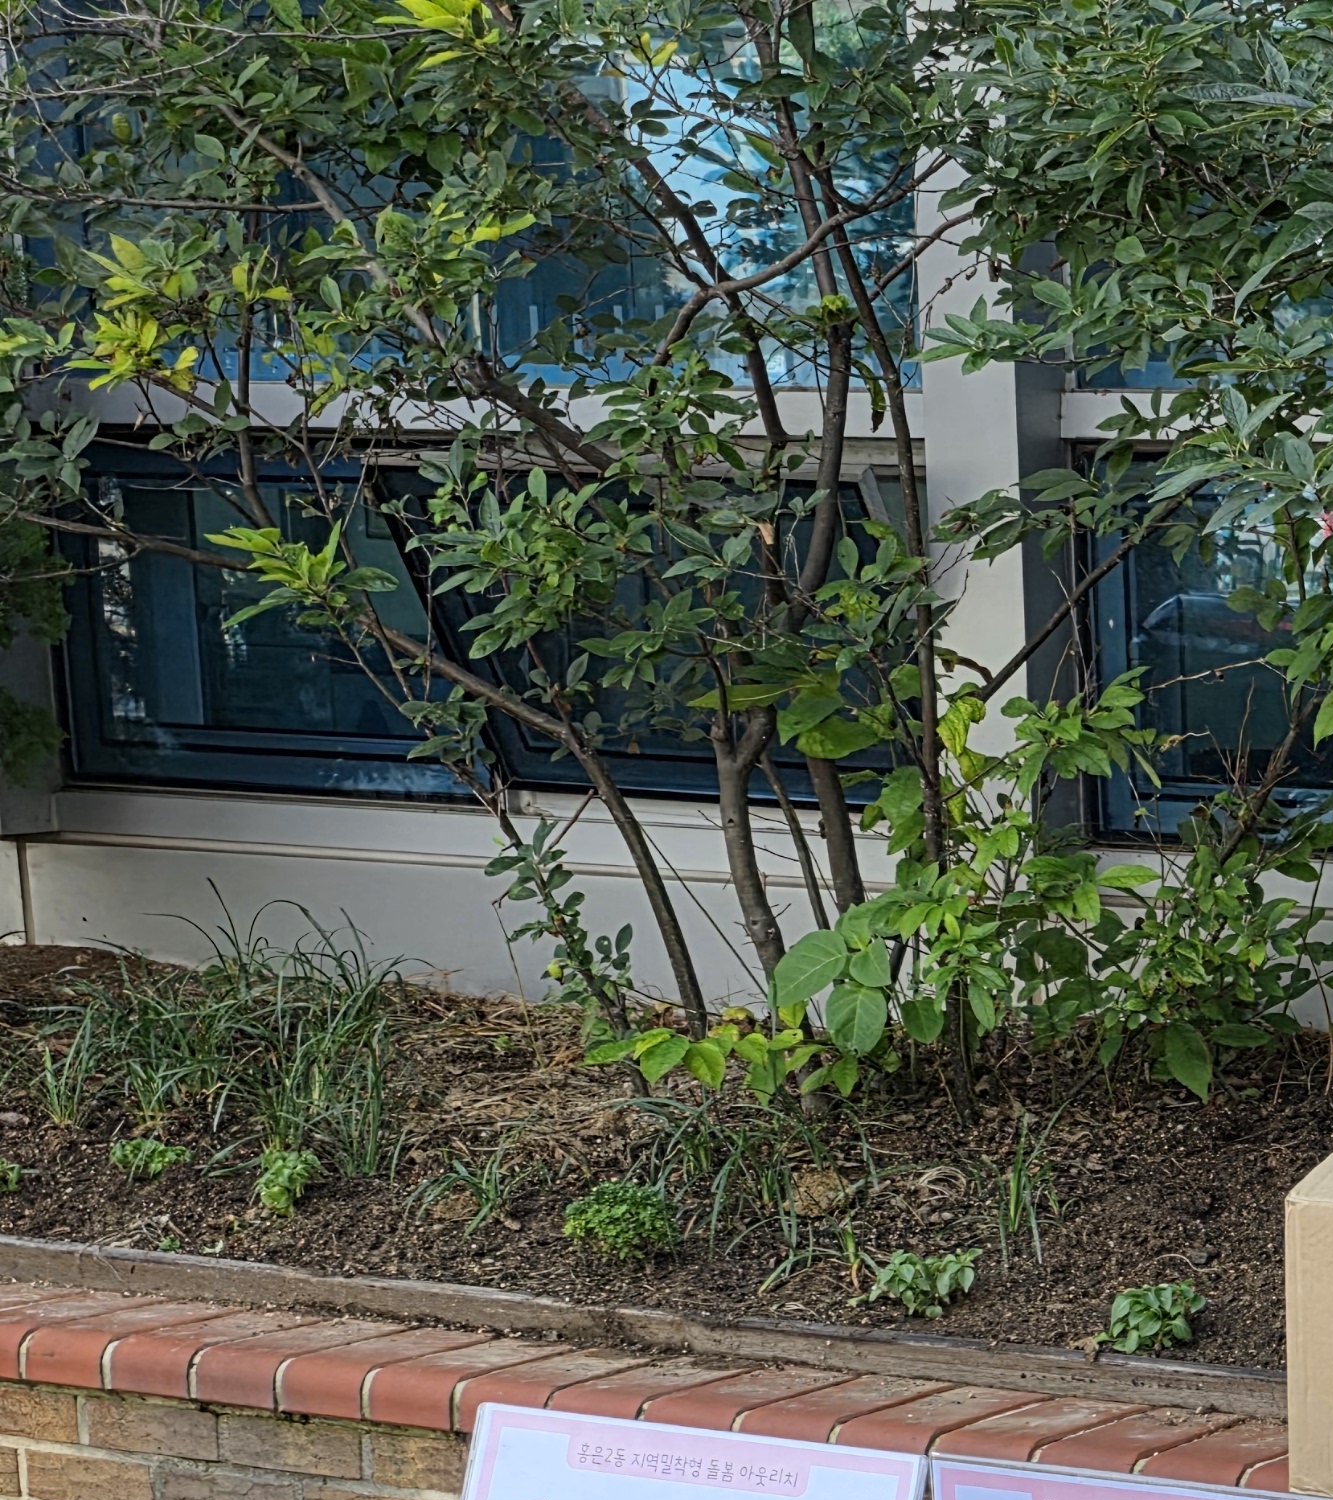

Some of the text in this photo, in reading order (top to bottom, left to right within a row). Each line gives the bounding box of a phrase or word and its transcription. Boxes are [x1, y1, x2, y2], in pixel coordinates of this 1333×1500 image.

[577, 1442, 798, 1488] 홍은2동 지역밀착형 돌봄 아웃리치
